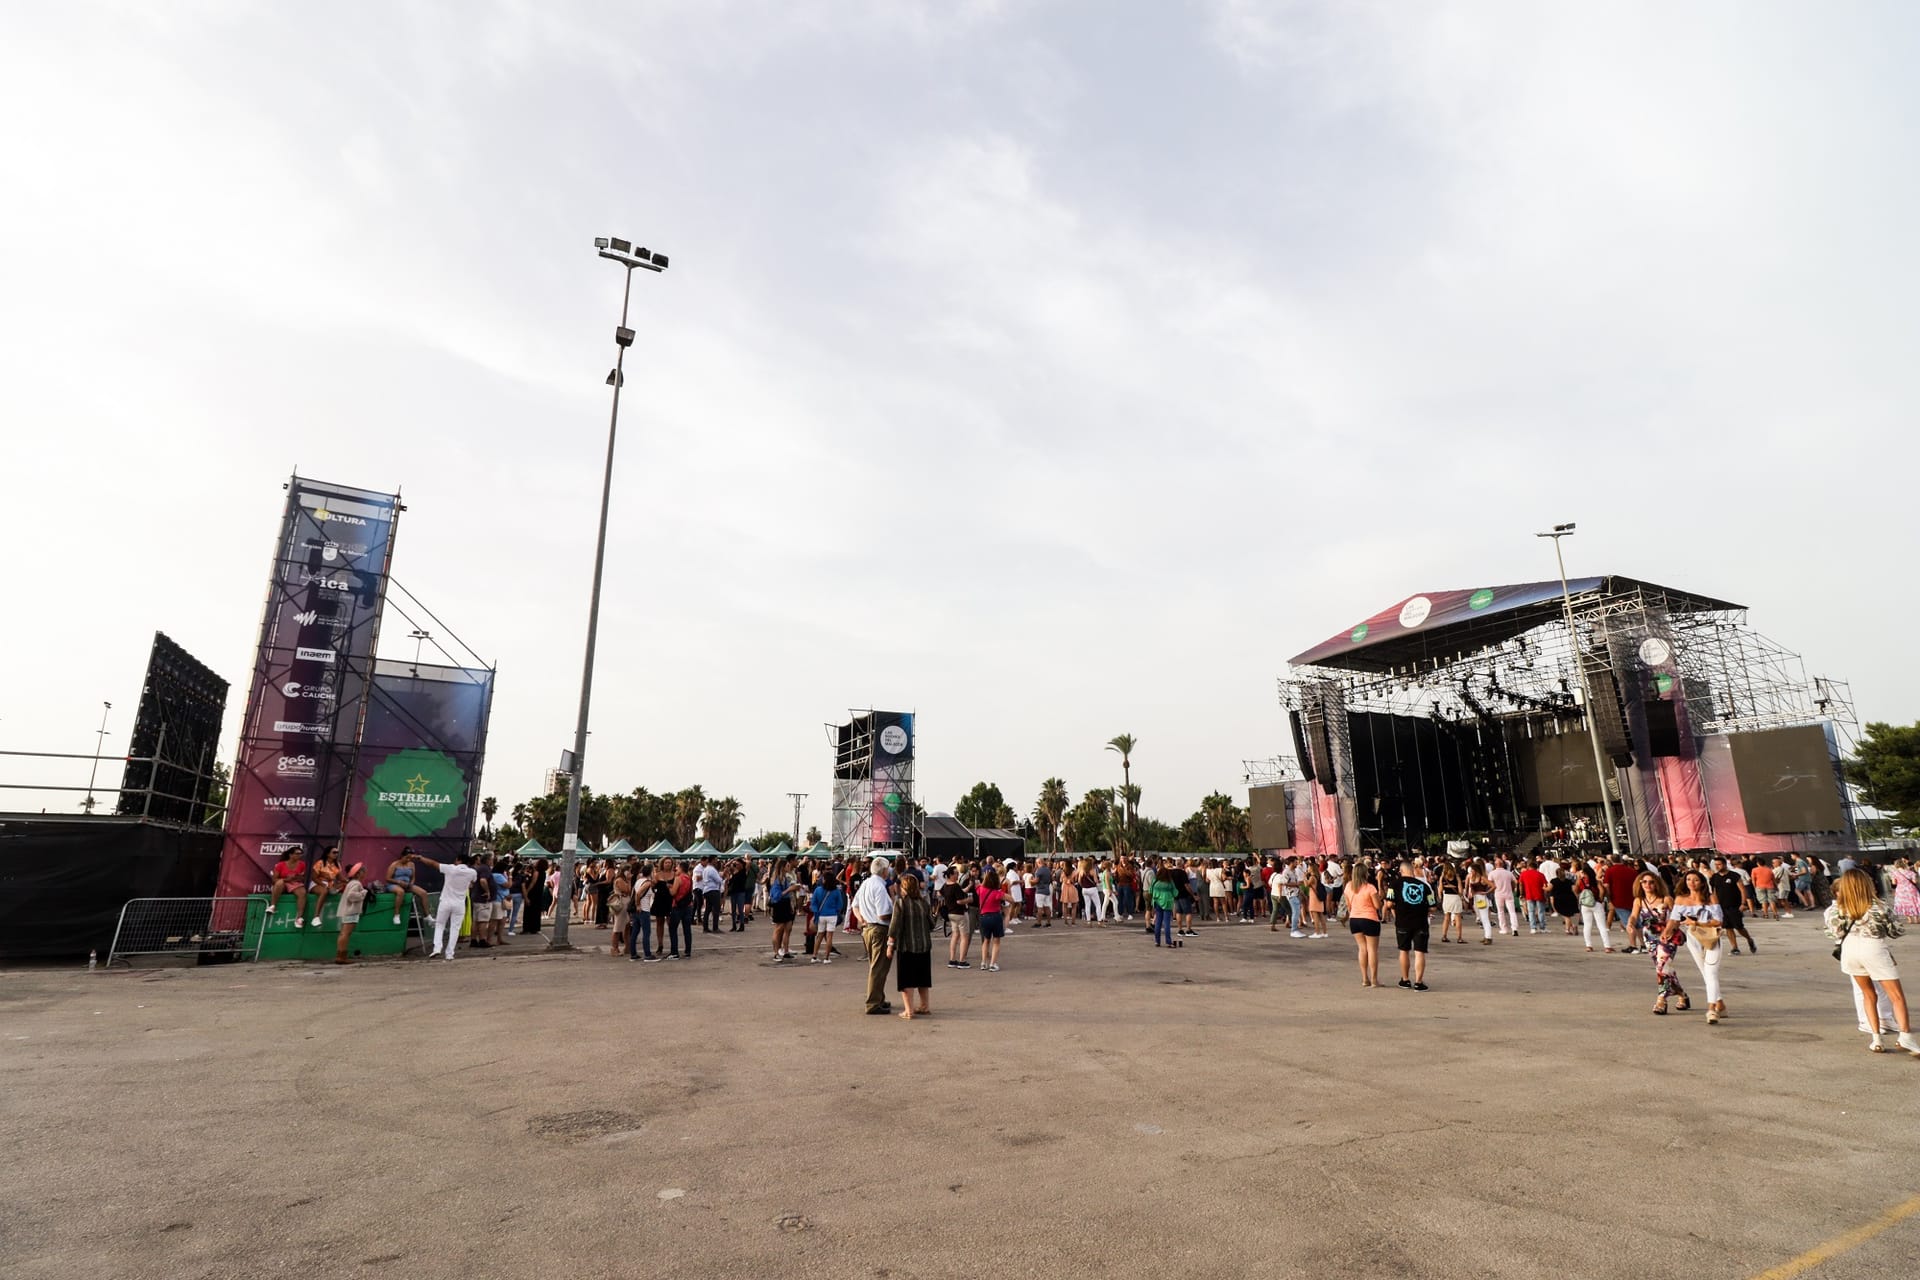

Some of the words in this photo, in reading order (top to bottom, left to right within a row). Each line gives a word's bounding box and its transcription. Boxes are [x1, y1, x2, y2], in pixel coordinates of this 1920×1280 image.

[320, 511, 366, 526] ULTURA
[320, 577, 349, 591] ica
[300, 650, 331, 659] inaem
[303, 685, 331, 694] GRUPO
[302, 691, 336, 700] CALICHE
[378, 791, 452, 804] ESTRELLA
[260, 844, 297, 854] MUNI
